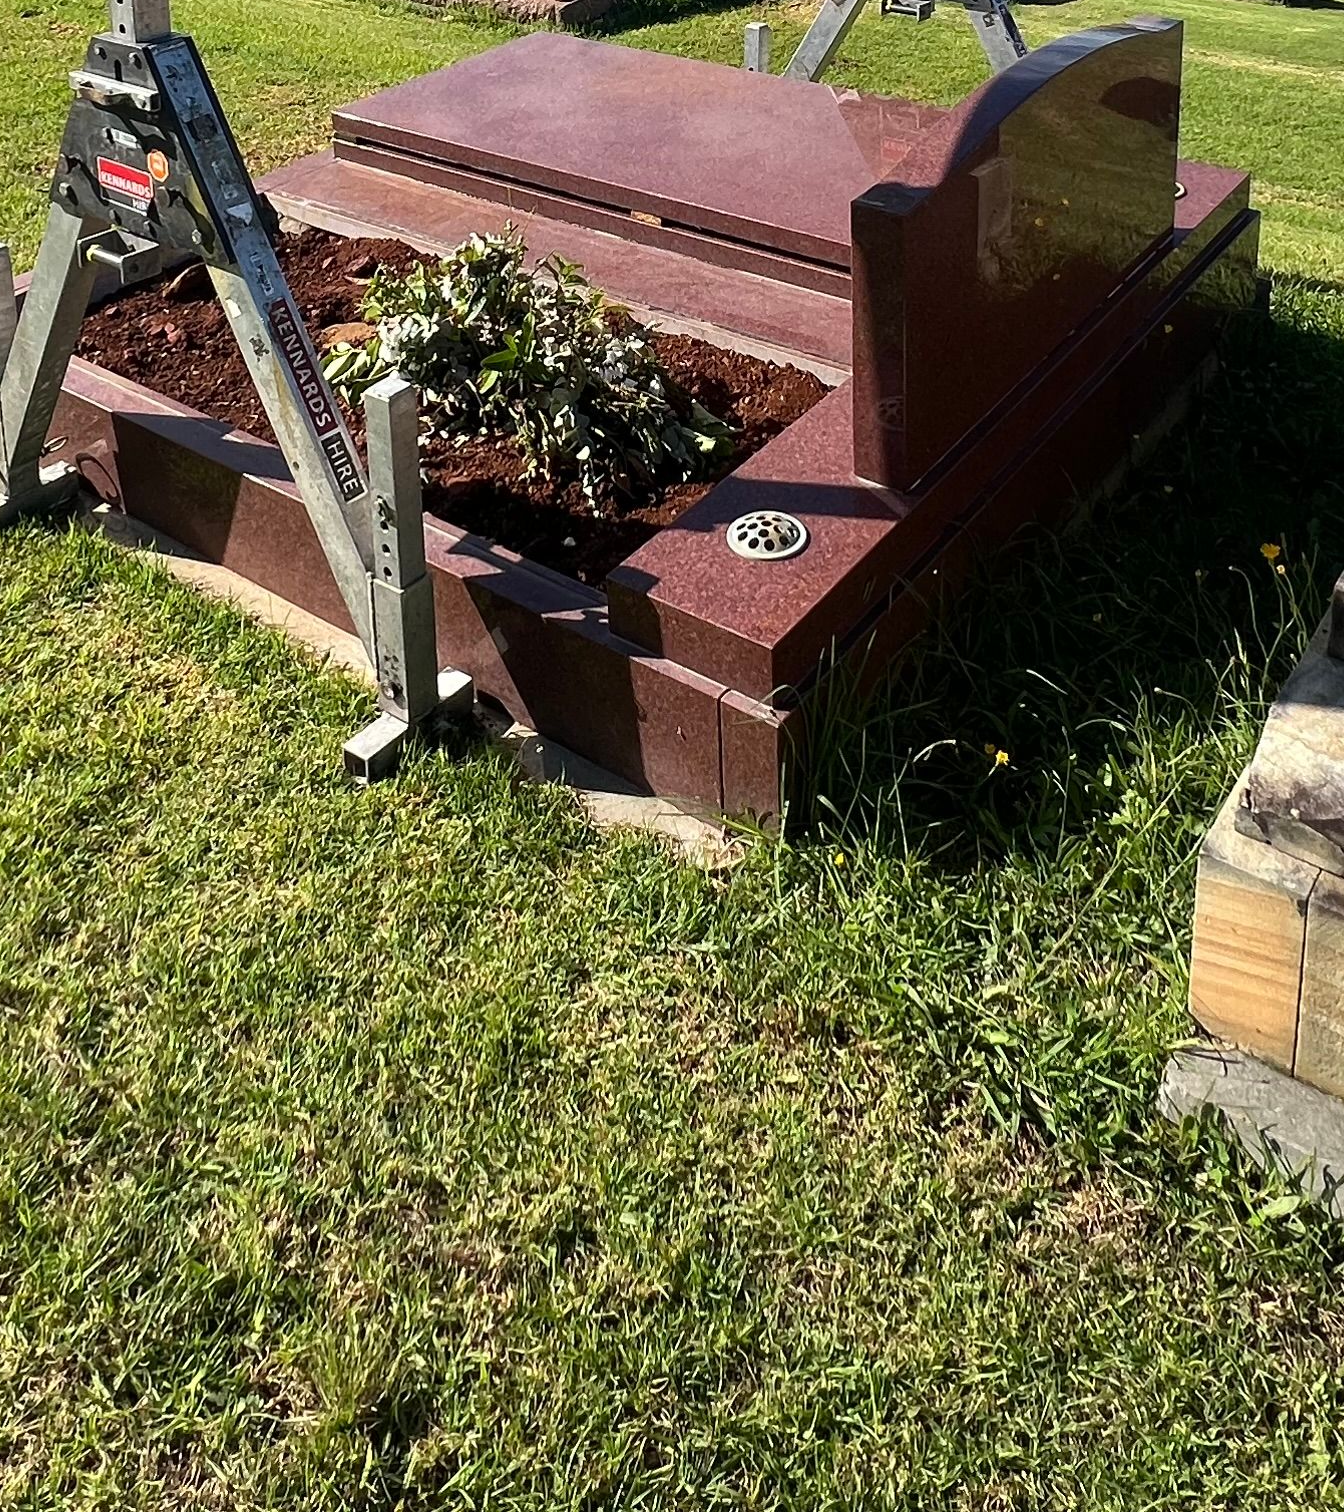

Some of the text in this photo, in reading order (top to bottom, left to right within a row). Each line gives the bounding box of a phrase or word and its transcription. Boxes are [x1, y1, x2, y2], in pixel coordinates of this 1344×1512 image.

[101, 172, 151, 197] KENNARDS
[270, 307, 360, 495] KENNARDS HIRE
